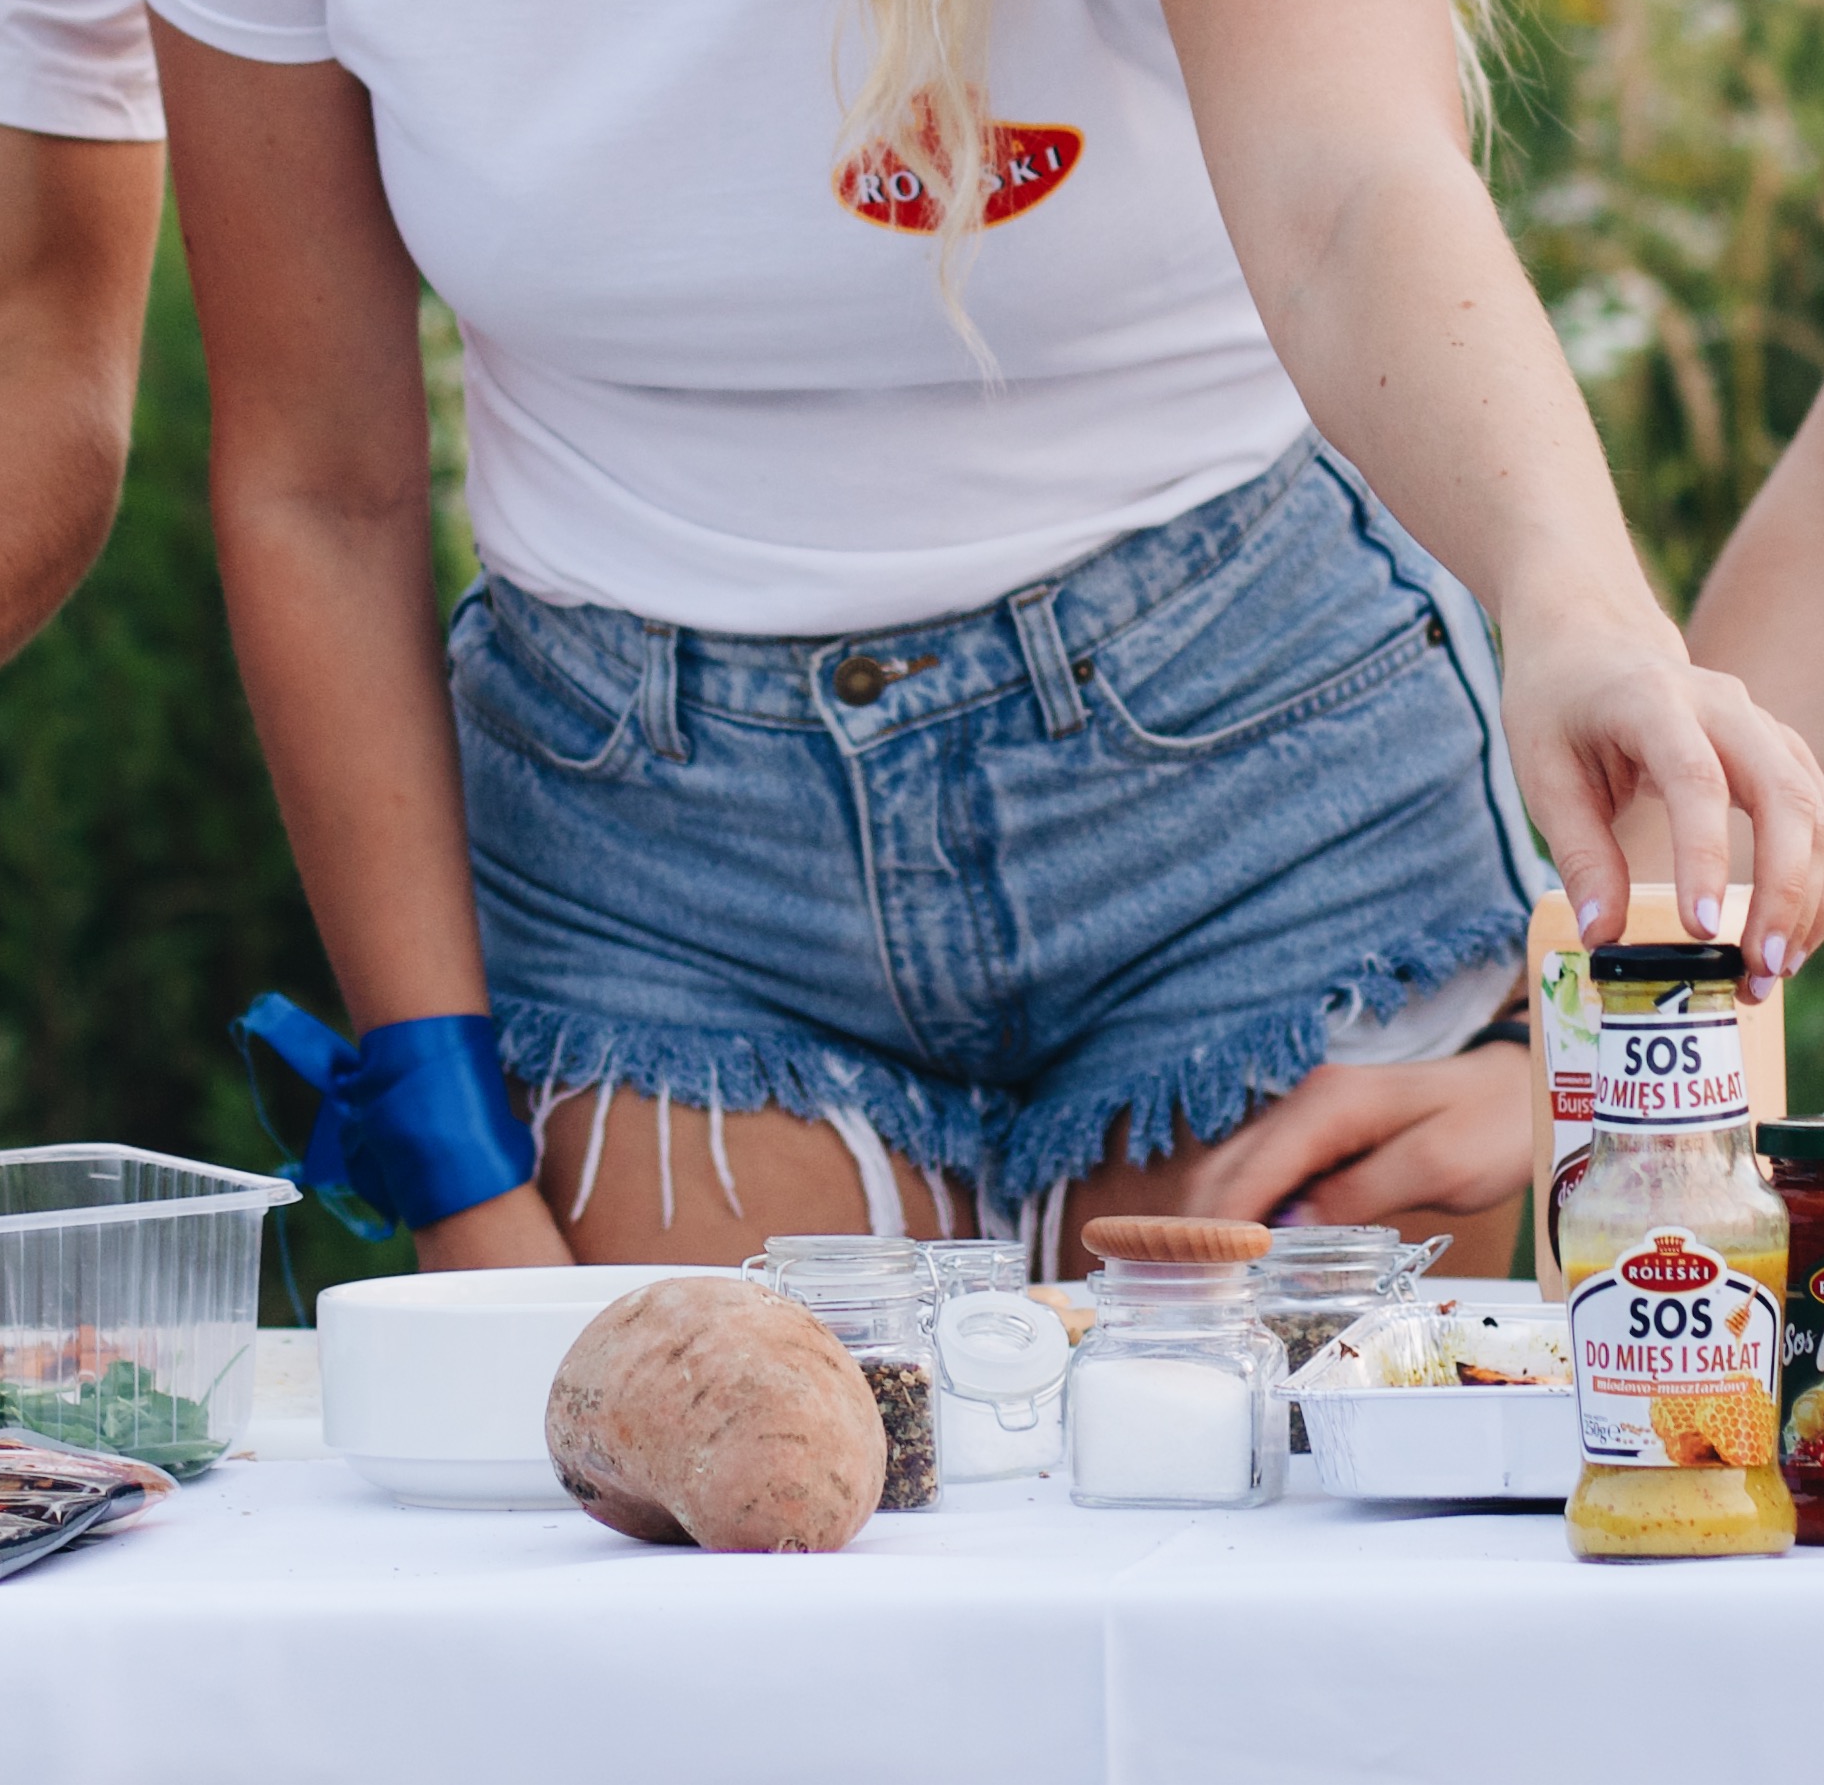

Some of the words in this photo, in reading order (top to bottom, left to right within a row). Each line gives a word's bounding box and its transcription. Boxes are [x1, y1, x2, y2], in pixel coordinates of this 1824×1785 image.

[857, 145, 1063, 204] ROSKI
[1624, 1035, 1702, 1076] SOS
[1611, 1079, 1666, 1117] MIĘS
[1673, 1082, 1680, 1109] I
[1687, 1071, 1743, 1108] SAŁAT
[1628, 1265, 1710, 1281] ROLESKI
[1629, 1297, 1713, 1339] SOS
[1585, 1339, 1610, 1370] DO
[1616, 1344, 1674, 1380] MIĘS
[1681, 1346, 1688, 1373] I
[1696, 1342, 1761, 1373] SAŁAT
[1782, 1322, 1816, 1366] Sos
[1596, 1377, 1750, 1395] miodowo-musztardowy
